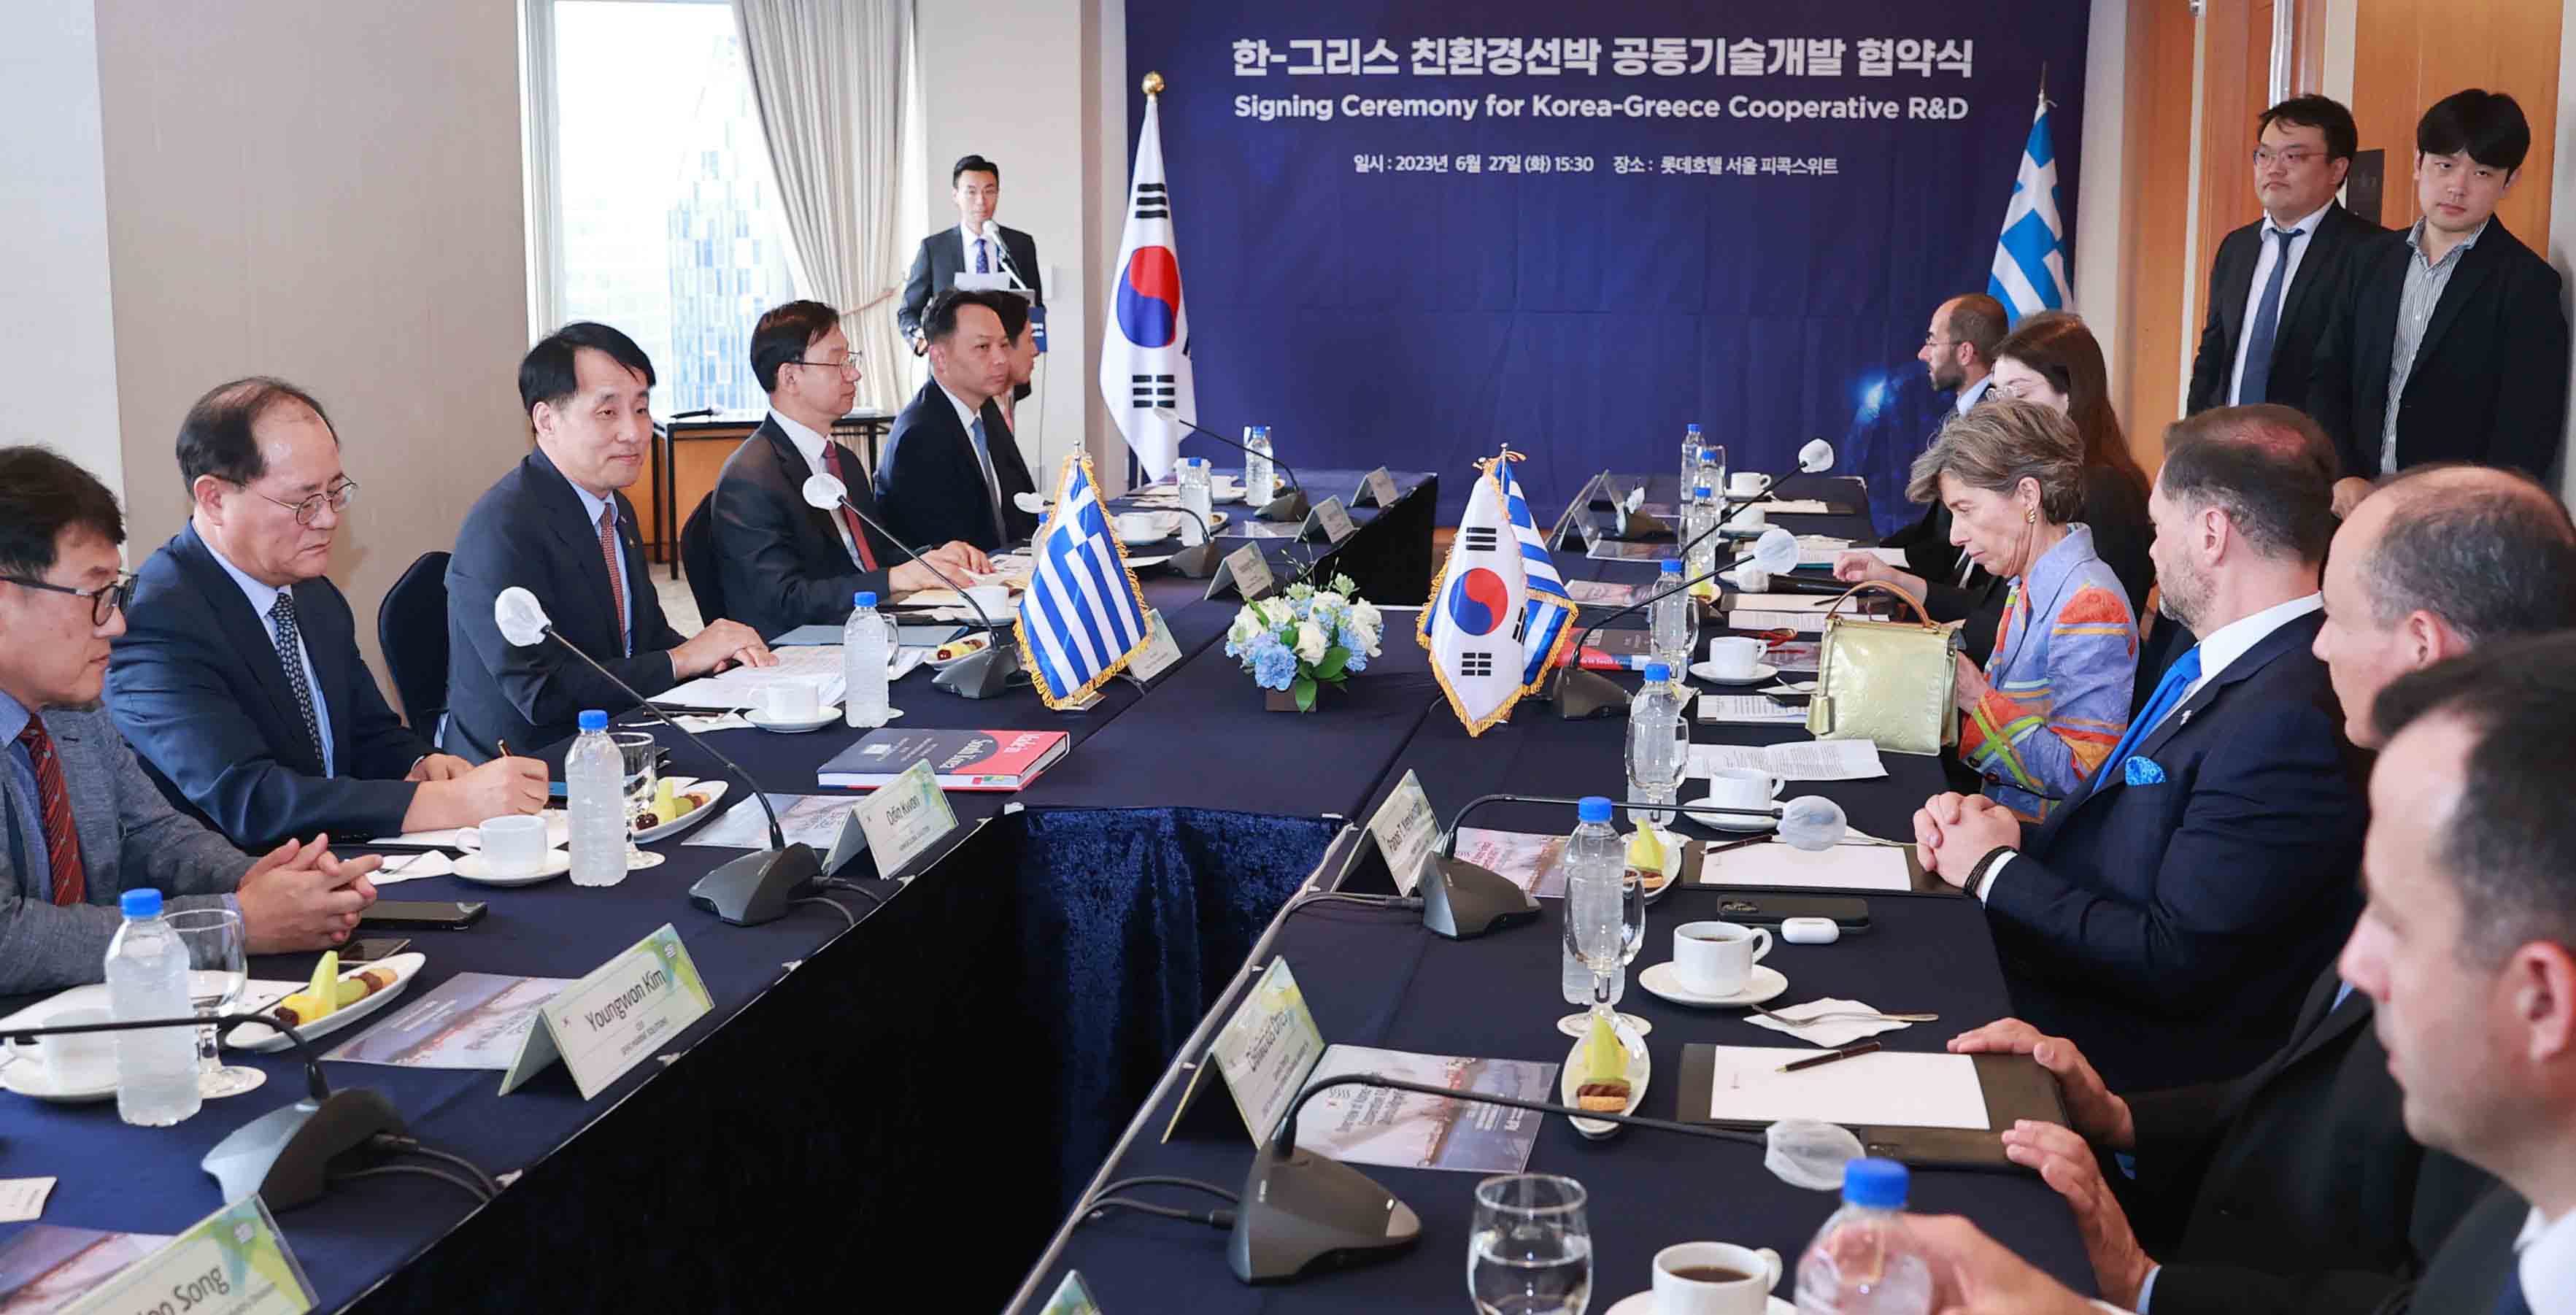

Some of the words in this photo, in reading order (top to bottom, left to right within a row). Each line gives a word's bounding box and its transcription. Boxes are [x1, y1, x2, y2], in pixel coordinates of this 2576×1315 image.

[1233, 38, 1400, 77] 한-그리스
[1411, 36, 1602, 76] 친환경선박
[1611, 37, 1846, 77] 공동기술개발
[1856, 38, 1973, 78] 협약식
[1235, 94, 1333, 121] Signing
[1341, 94, 1478, 121] Ceremony
[1485, 93, 1525, 117] for
[1532, 94, 1721, 117] Korea-Greece
[1728, 96, 1900, 122] Cooperative
[1908, 97, 1968, 120] R&D
[1395, 154, 1449, 173] 2023년
[1455, 154, 1481, 174] 6월
[1554, 156, 1594, 172] 15:30
[1660, 155, 1723, 175] 롯데호텔
[1726, 156, 1758, 175] 서울
[1760, 156, 1838, 176] 피콕스위트
[585, 984, 647, 1032] Youngwon
[641, 970, 666, 993] Kim
[171, 1266, 231, 1313] Song
